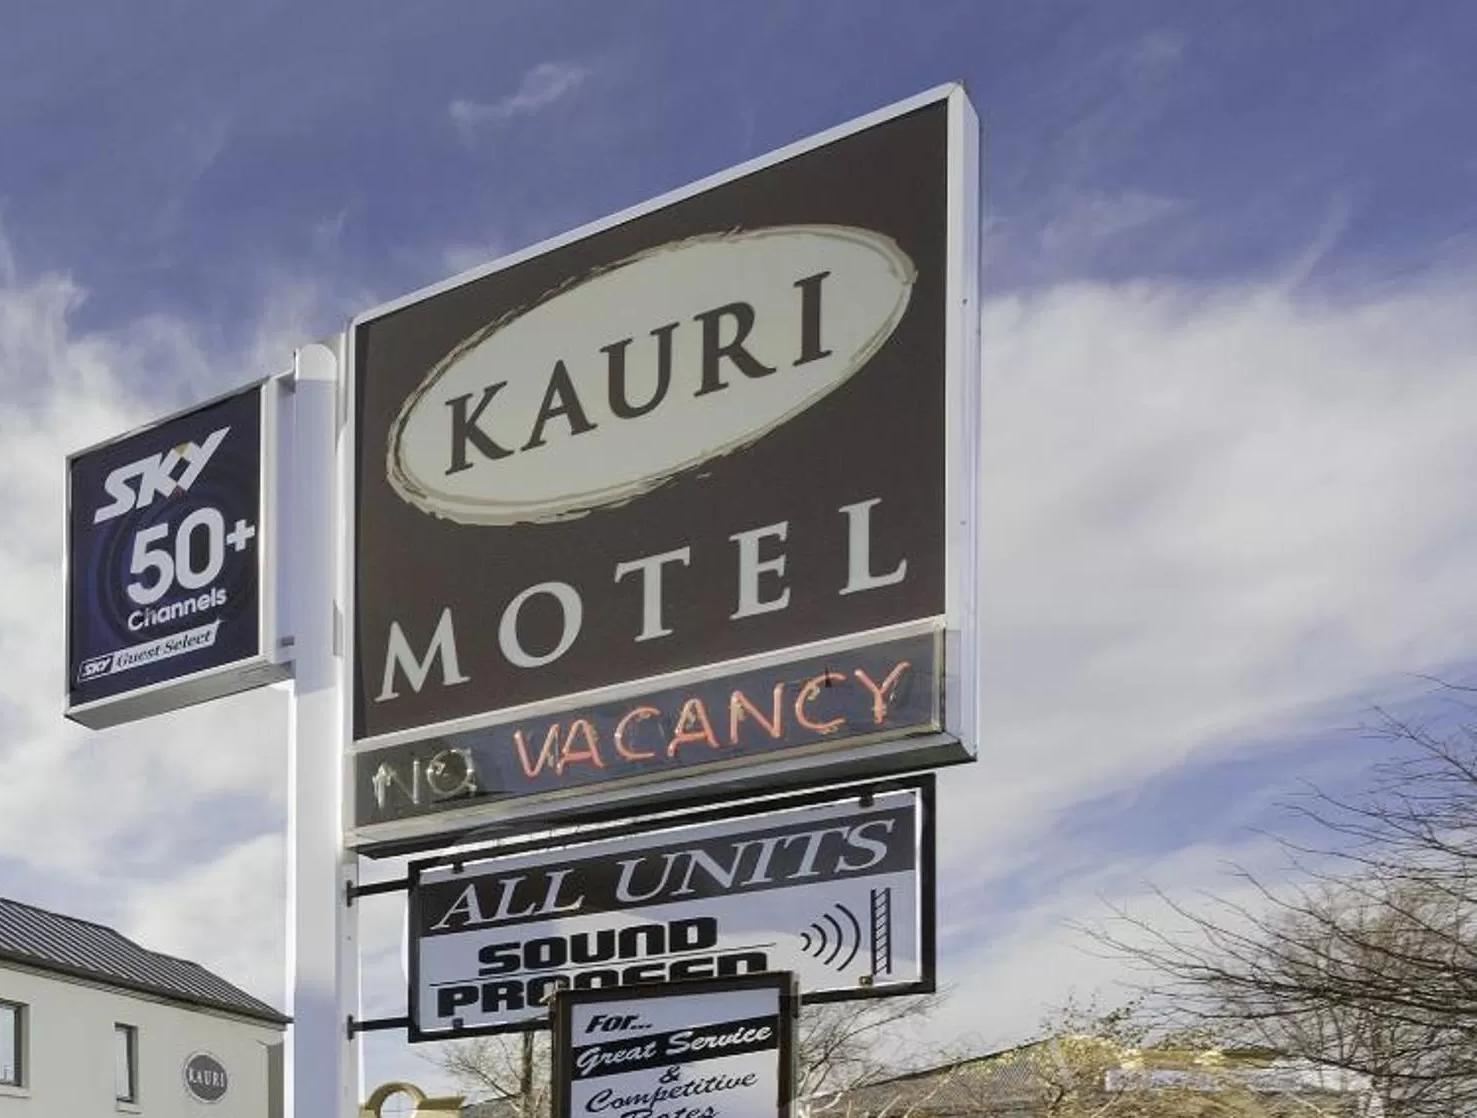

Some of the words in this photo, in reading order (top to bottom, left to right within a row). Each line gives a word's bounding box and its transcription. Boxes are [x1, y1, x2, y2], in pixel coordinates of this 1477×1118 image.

[445, 271, 833, 476] KAURI
[93, 426, 231, 524] SKY
[126, 506, 256, 605] 50+
[127, 587, 228, 631] Channels
[375, 497, 908, 704] MOTEL
[118, 646, 162, 667] Guest
[163, 630, 211, 654] Select
[372, 748, 478, 809] NO
[513, 660, 911, 779] VACANCY
[430, 867, 585, 931] ALL
[615, 817, 896, 902] UNITS
[478, 916, 719, 977] SOUND
[188, 1066, 226, 1088] KAURI
[576, 1041, 658, 1076] Great
[665, 1025, 773, 1056] Service
[659, 1065, 683, 1085] &
[585, 1072, 759, 1113] Competitive
